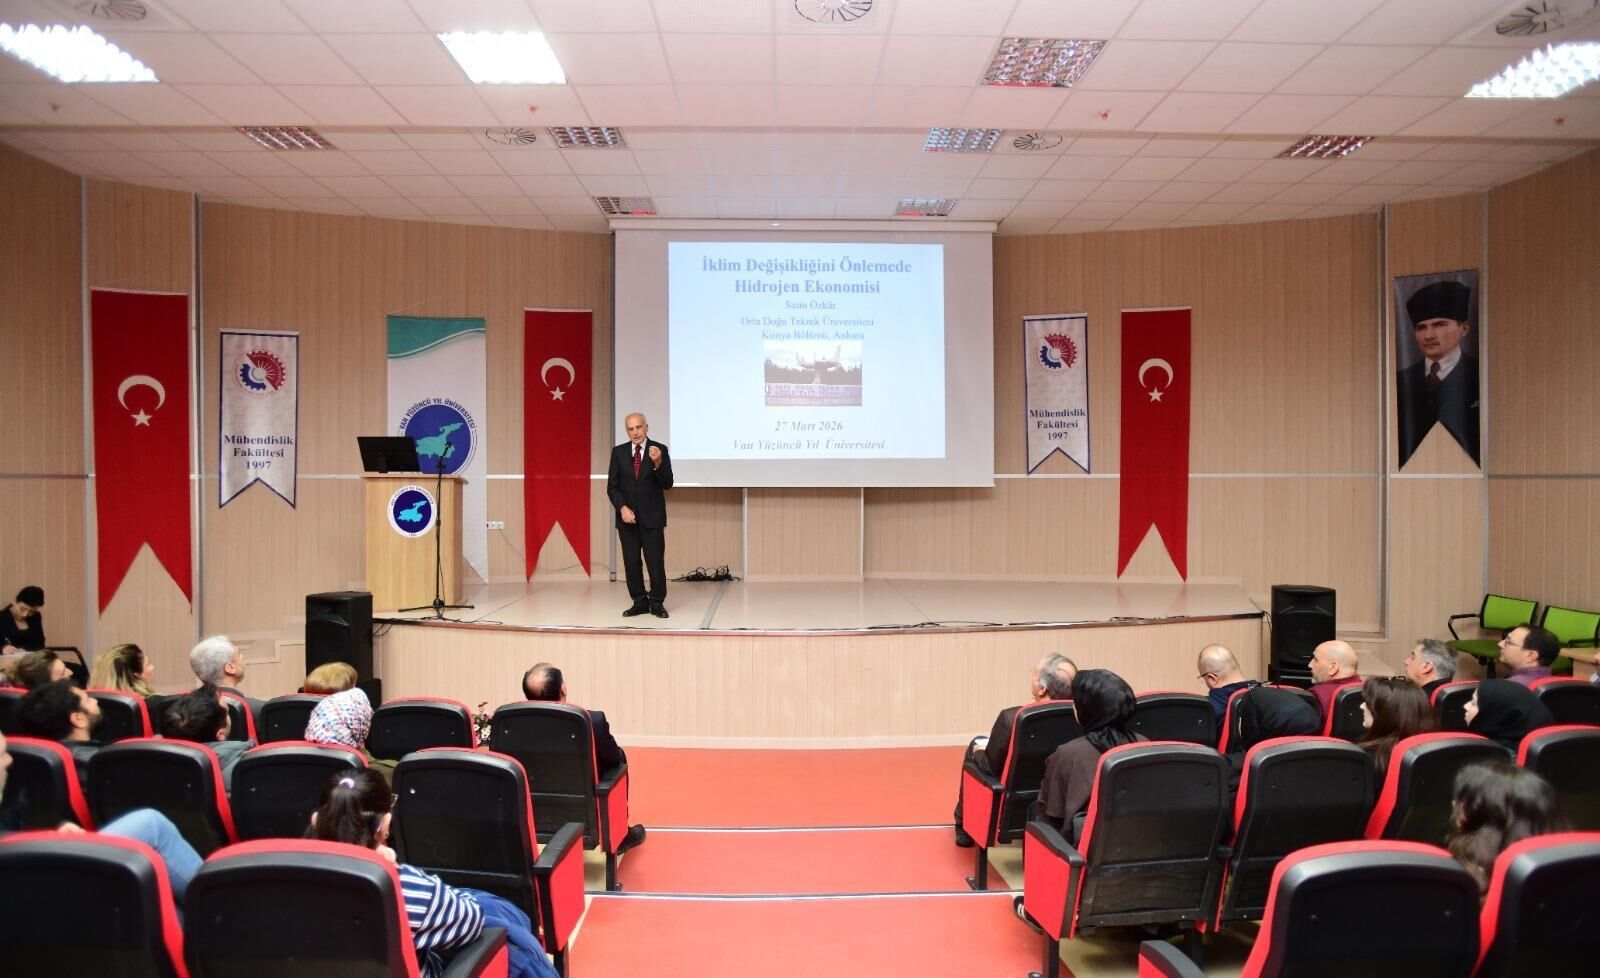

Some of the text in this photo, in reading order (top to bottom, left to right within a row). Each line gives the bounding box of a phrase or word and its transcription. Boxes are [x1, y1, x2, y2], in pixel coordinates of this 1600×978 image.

[702, 256, 912, 275] İklim Değişikliğini Önlemede
[735, 279, 880, 296] Hidrojen Ekonomisi
[785, 301, 808, 310] Saim
[741, 315, 874, 327] Orta Doğu Teknik Üniversitesi
[833, 331, 865, 340] Ankara
[399, 417, 409, 429] VAN
[406, 398, 432, 418] YÜZÜNCÜ
[445, 398, 477, 429] ÜNİVERSİTESİ
[1030, 409, 1086, 418] Mühendislik
[774, 420, 844, 431] 27 Mart 2026
[1037, 420, 1079, 429] Fakültesi
[224, 435, 294, 445] Mühendislik
[1048, 432, 1068, 440] 1997
[733, 437, 886, 451] Van Yüzüncü Yıl Üniversitesi
[233, 448, 285, 457] Fakültesi
[246, 461, 272, 470] 1997
